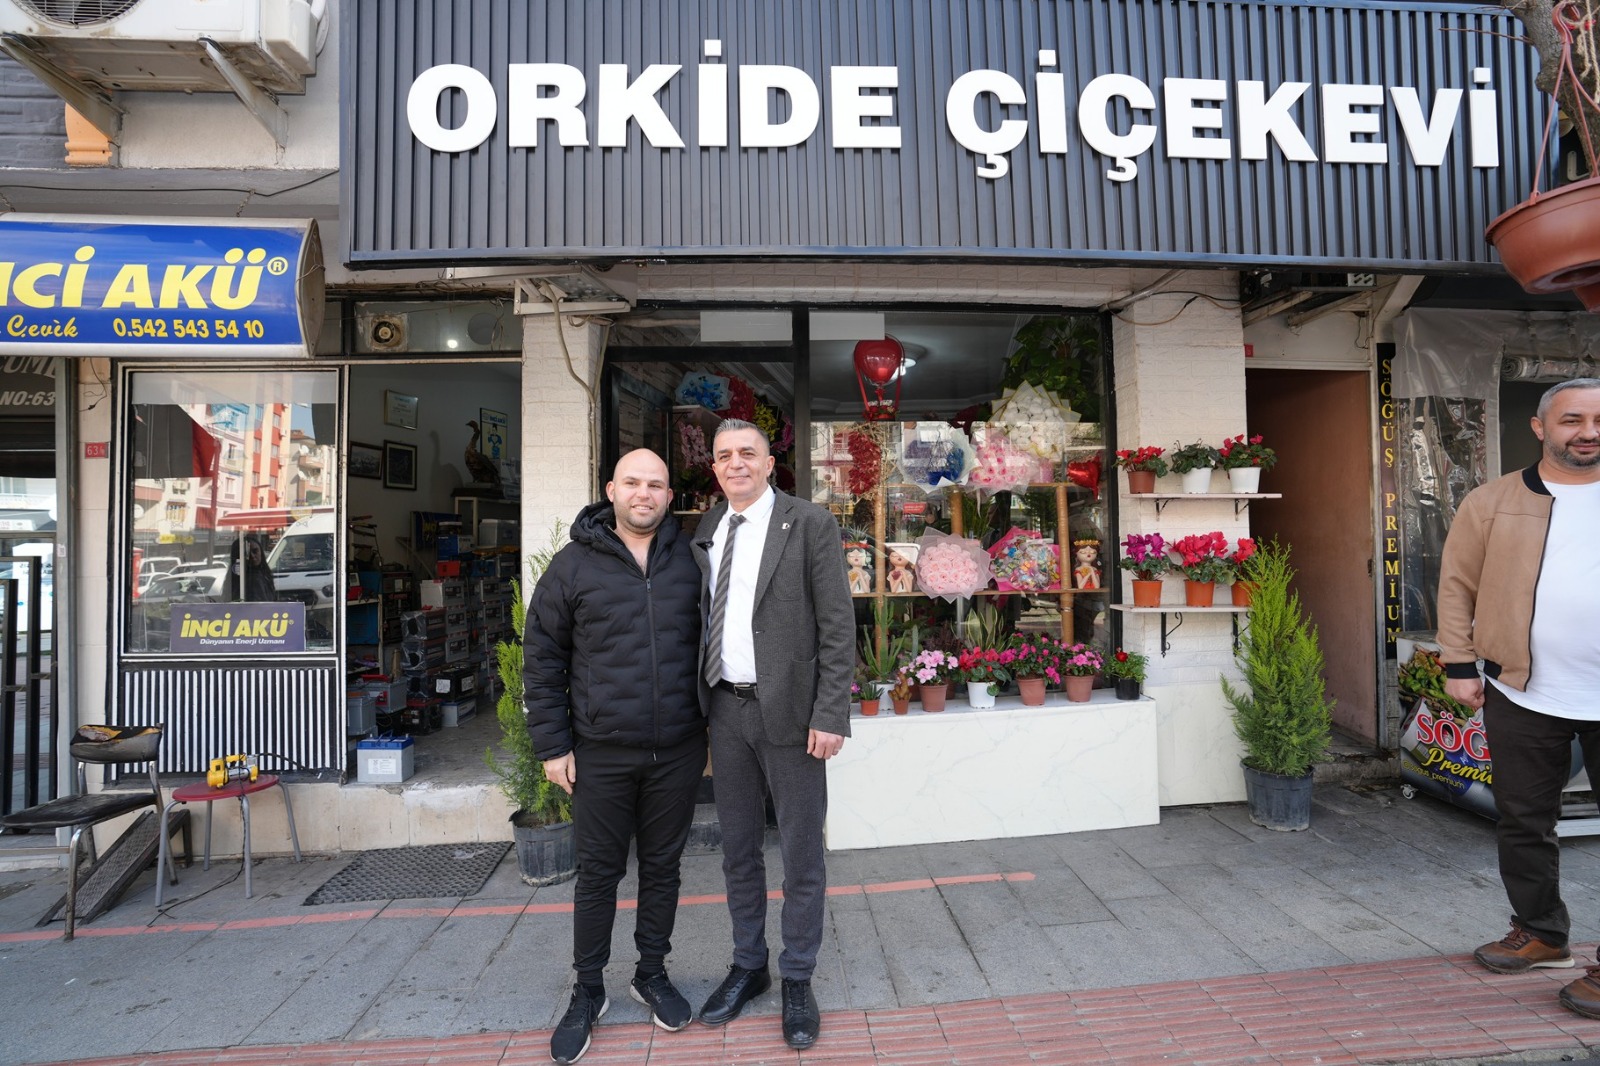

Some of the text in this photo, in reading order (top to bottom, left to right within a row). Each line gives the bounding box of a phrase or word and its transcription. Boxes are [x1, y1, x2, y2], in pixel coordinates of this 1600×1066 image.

[407, 39, 1499, 182] ORKİDE ÇİÇEKEVİ
[113, 318, 168, 338] 0.542
[173, 319, 209, 338] 543
[215, 320, 239, 338] 54
[244, 319, 264, 338] 10
[180, 613, 231, 638] İNCİ
[200, 638, 234, 646] Dünyanın
[235, 638, 257, 646] Enerji
